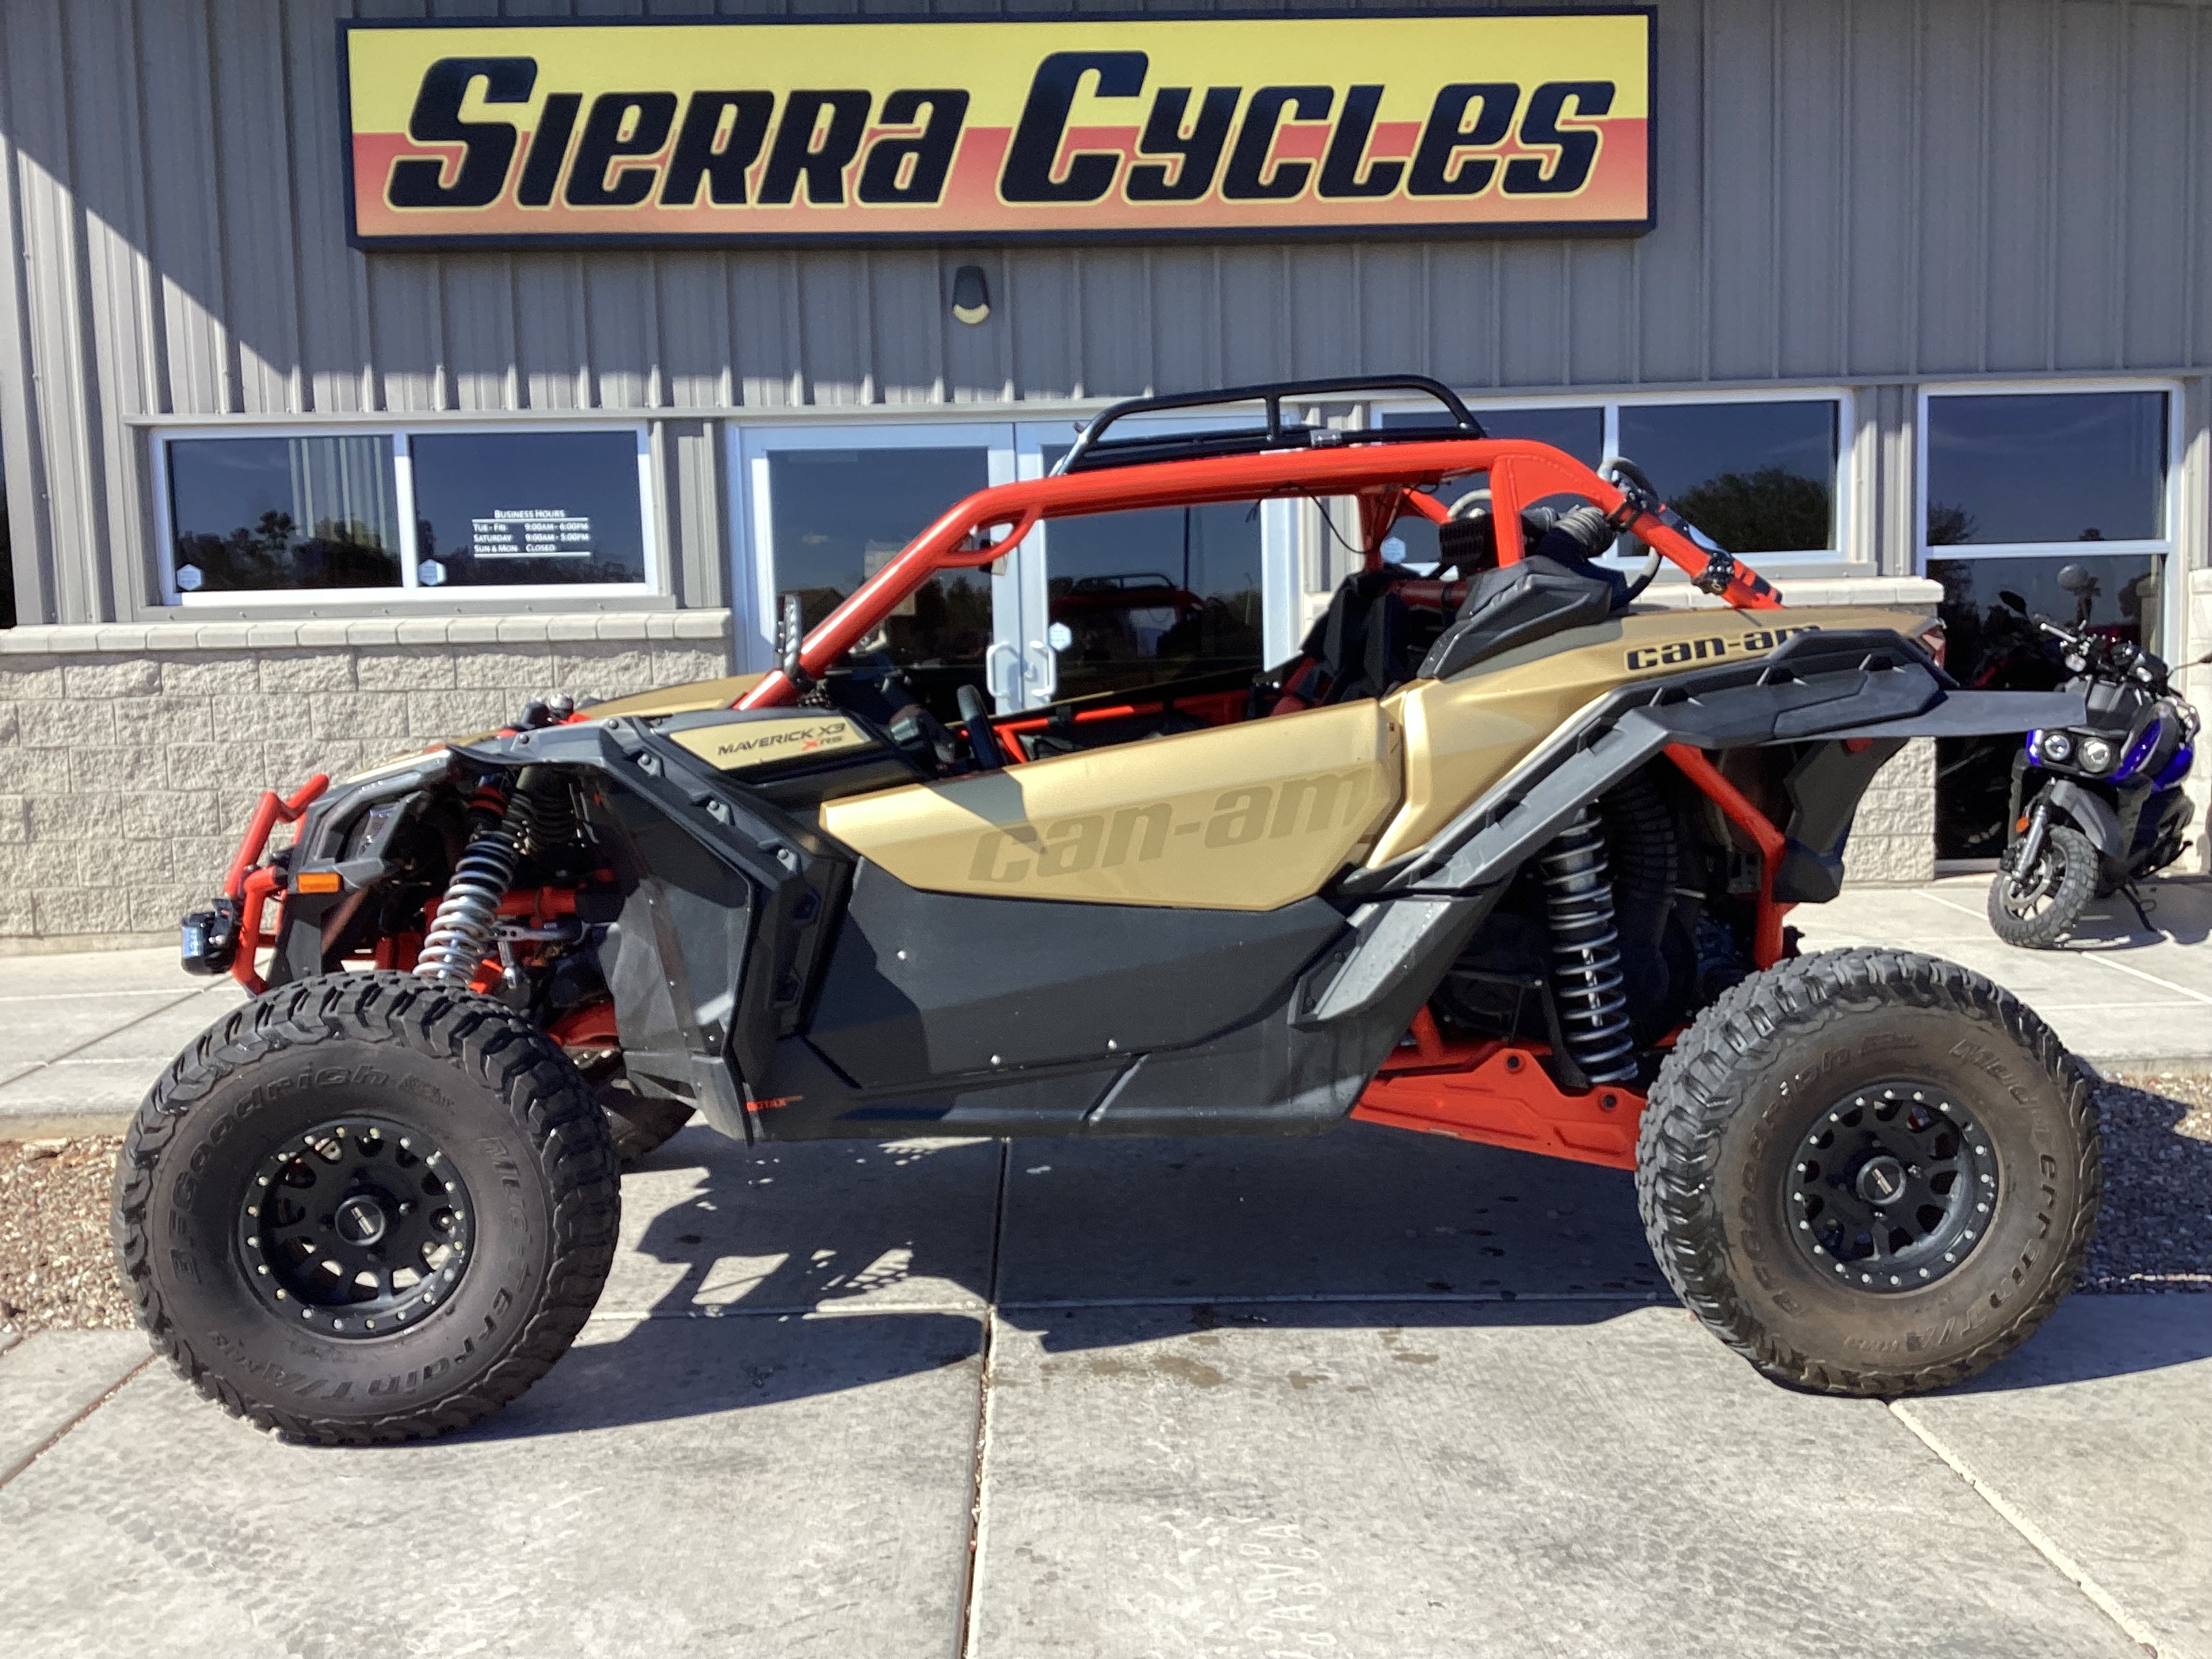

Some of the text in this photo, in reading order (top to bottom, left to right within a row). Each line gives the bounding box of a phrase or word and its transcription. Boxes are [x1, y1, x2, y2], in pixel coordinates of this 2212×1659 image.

[494, 509, 565, 518] BUSINESS HOURS
[474, 534, 512, 542] SATURDAY
[474, 544, 490, 552] SUN
[498, 544, 518, 552] MON
[525, 544, 556, 552] CLOSED
[718, 722, 846, 755] MAVERICK X3
[968, 768, 1372, 882] can-am
